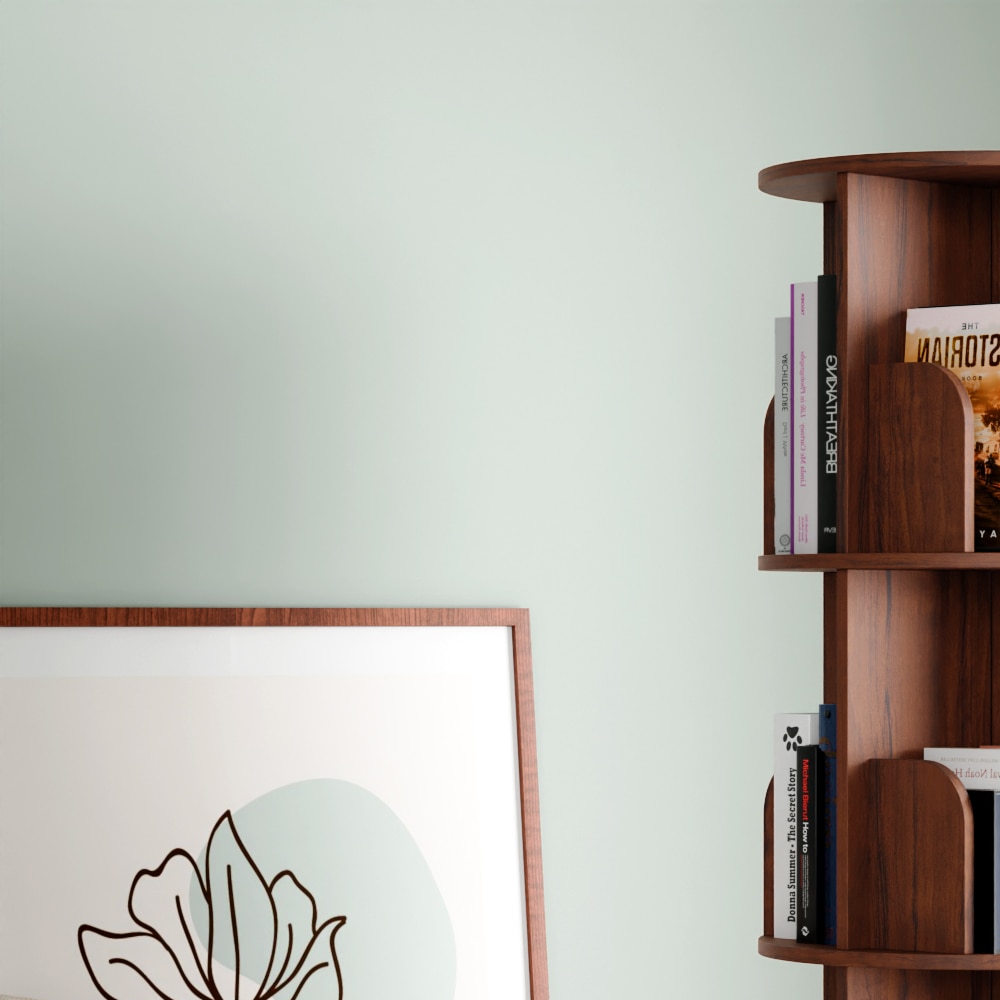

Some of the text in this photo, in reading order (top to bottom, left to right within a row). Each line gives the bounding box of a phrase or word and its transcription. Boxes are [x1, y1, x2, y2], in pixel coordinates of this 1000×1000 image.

[787, 767, 798, 923] Donna Summer The Secret Story
[802, 843, 809, 854] to
